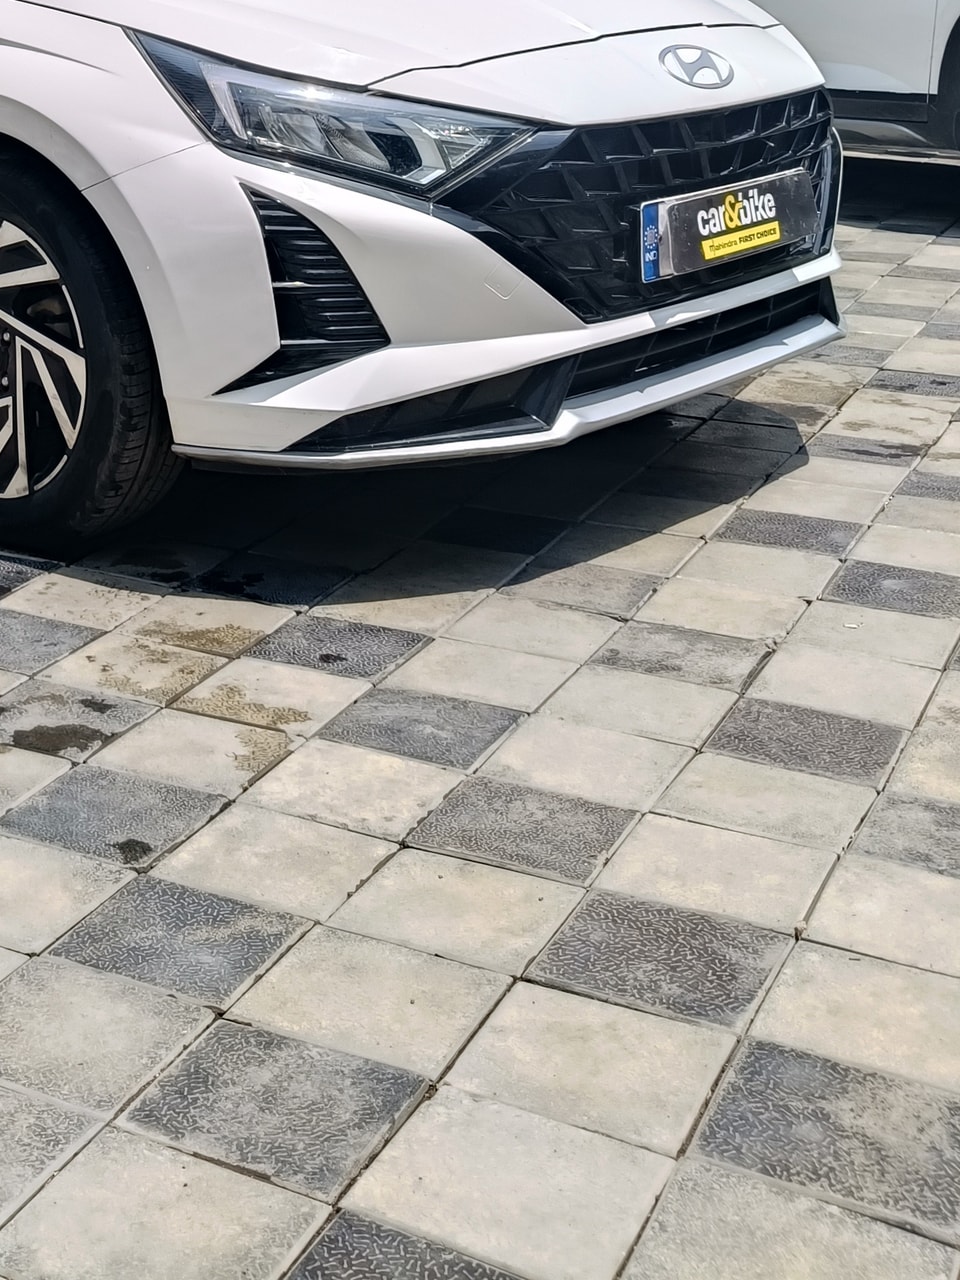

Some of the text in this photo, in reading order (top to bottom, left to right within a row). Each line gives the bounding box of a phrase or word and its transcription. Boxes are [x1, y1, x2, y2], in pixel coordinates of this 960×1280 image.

[697, 188, 776, 236] car&bike
[709, 228, 777, 252] Mahindra FIRST CHOICE
